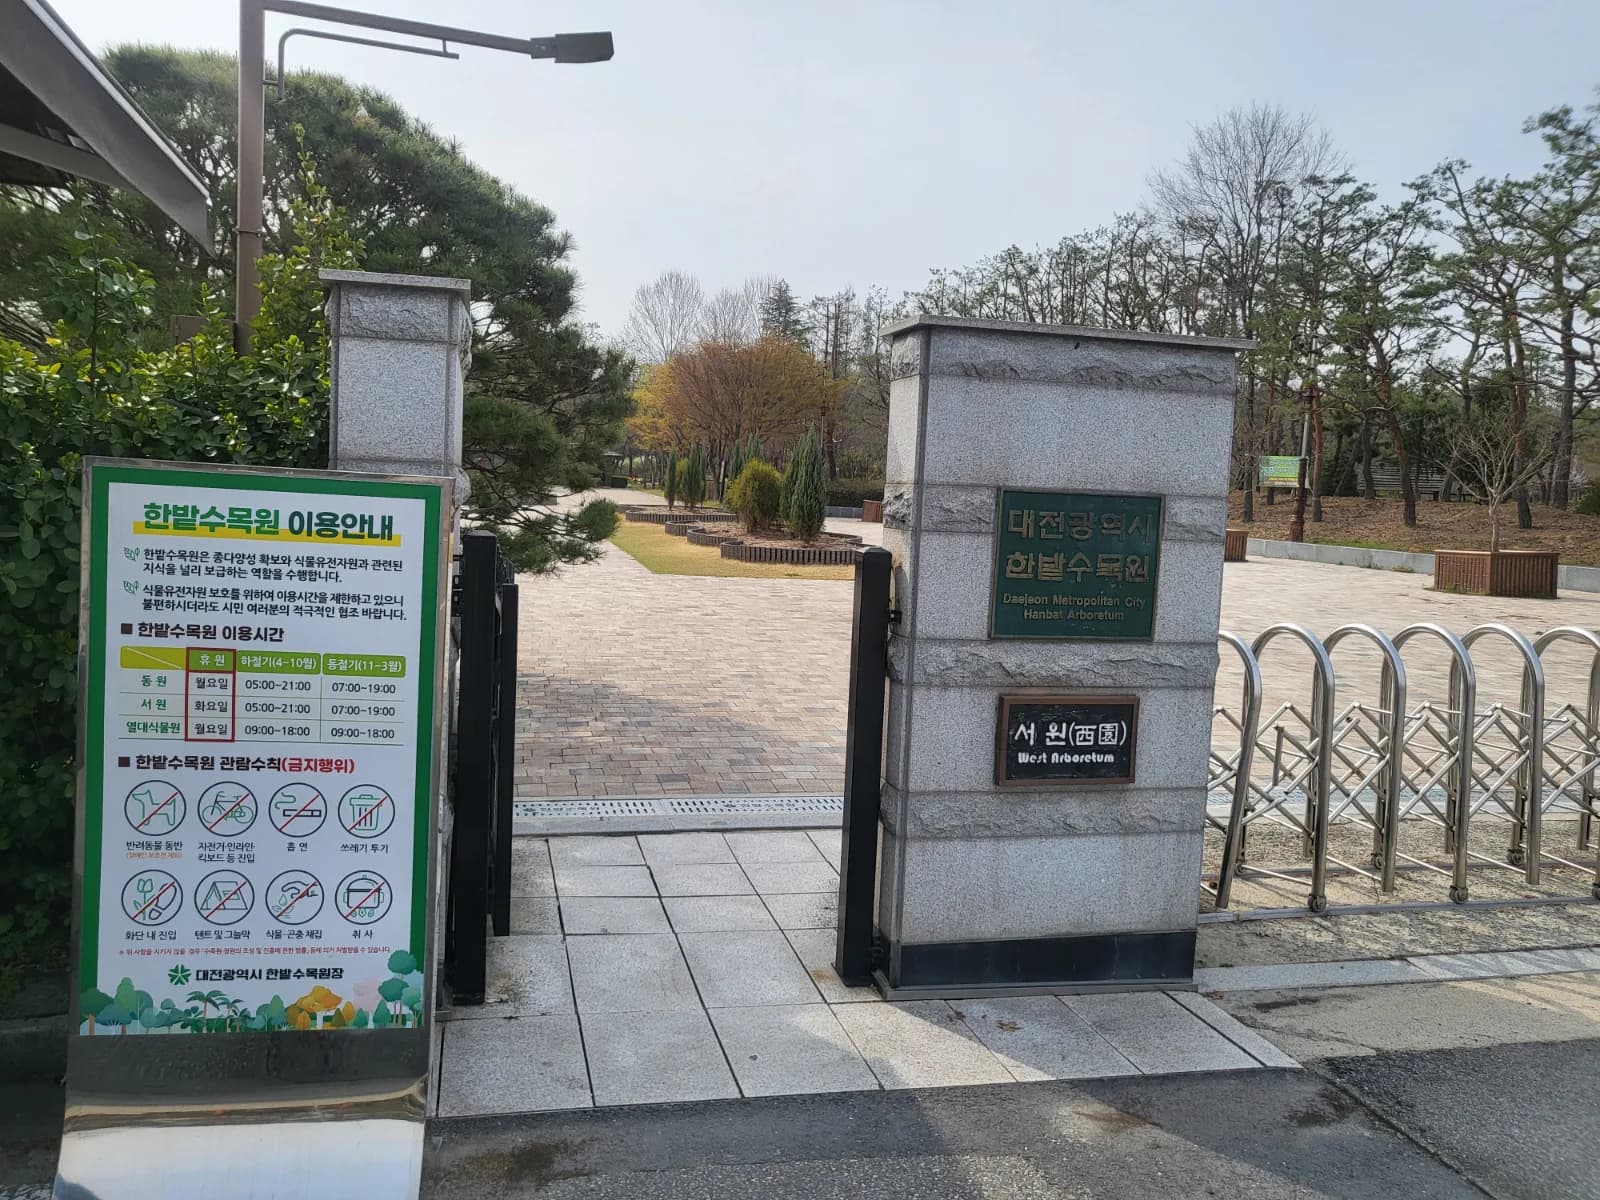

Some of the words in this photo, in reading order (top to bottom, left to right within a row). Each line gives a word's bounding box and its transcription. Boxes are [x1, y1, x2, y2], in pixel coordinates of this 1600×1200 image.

[144, 502, 279, 535] 한밭수목원
[288, 510, 393, 541] 이용안내
[1008, 509, 1153, 545] 대전광역시
[144, 548, 209, 563] 한밭수목원은
[213, 551, 256, 565] 종다양성
[259, 553, 291, 566] 확보와
[294, 554, 367, 569] 식물유전자원과
[371, 558, 402, 571] 관련된
[144, 562, 176, 575] 지식을
[180, 564, 201, 576] 널리
[204, 565, 248, 579] 보급하는
[252, 567, 283, 580] 역할을
[286, 567, 342, 583] 수행합니다.
[1006, 551, 1149, 583] 한밭수목원
[144, 584, 207, 598] 식물유전자원
[209, 586, 240, 600] 보호를
[244, 587, 274, 602] 위하여
[277, 589, 328, 603] 이용시간을
[330, 591, 370, 605] 제한하고
[374, 593, 403, 606] 있으니
[1004, 592, 1048, 606] Daejeon
[1053, 594, 1120, 607] Metropolitan
[1126, 597, 1145, 608] City
[142, 598, 220, 612] 불편하시더라도
[223, 600, 243, 614] 시민
[247, 601, 290, 616] 여러분의
[293, 603, 335, 617] 적극적인
[338, 605, 358, 618] 협조
[362, 606, 407, 621] 바랍니다.
[1024, 609, 1063, 620] Hanbat
[1068, 609, 1124, 621] Arboretum
[138, 622, 217, 639] 한밭수목원
[223, 625, 284, 642] 이용시간
[200, 654, 211, 666] 휴
[214, 655, 225, 666] 원
[241, 655, 317, 670] 하절기(4~10월)
[327, 659, 402, 672] 동절기(11~3월)
[141, 675, 151, 687] 동
[155, 675, 167, 688] 원
[195, 677, 228, 689] 월요일
[245, 680, 311, 691] 05:00~21:00
[331, 682, 396, 694] 07:00~19:00
[141, 698, 151, 711] 서
[155, 698, 167, 711] 원
[195, 700, 228, 713] 화요일
[245, 703, 311, 714] 05:00~21:00
[331, 705, 395, 717] 07:00~19:00
[126, 721, 180, 734] 열대식물원
[195, 723, 228, 735] 월요일
[245, 725, 310, 736] 09:00~18:00
[331, 728, 394, 739] 09:00~18:00
[1015, 723, 1035, 745] 서
[136, 755, 215, 771] 한밭수목원
[220, 757, 355, 773] 관람수칙(금지행위)
[1018, 752, 1047, 764] West
[1051, 753, 1114, 764] Arboretum
[126, 841, 163, 851] 반려동물
[166, 841, 183, 851] 동반
[287, 842, 296, 851] 흡
[299, 842, 307, 851] 연
[340, 844, 368, 853] 쓰레기
[371, 844, 388, 854] 투기
[199, 854, 224, 863] 킥보드
[227, 854, 235, 863] 등
[238, 854, 255, 863] 진입
[126, 931, 143, 940] 화단
[147, 931, 156, 940] 내
[159, 931, 176, 940] 진입
[195, 931, 213, 939] 텐트
[215, 931, 222, 939] 및
[224, 931, 250, 940] 그늘막
[306, 930, 322, 939] 채집
[353, 930, 360, 939] 취
[365, 930, 373, 939] 사
[196, 968, 262, 982] 대전광역시
[266, 966, 344, 981] 한밭수목원장
